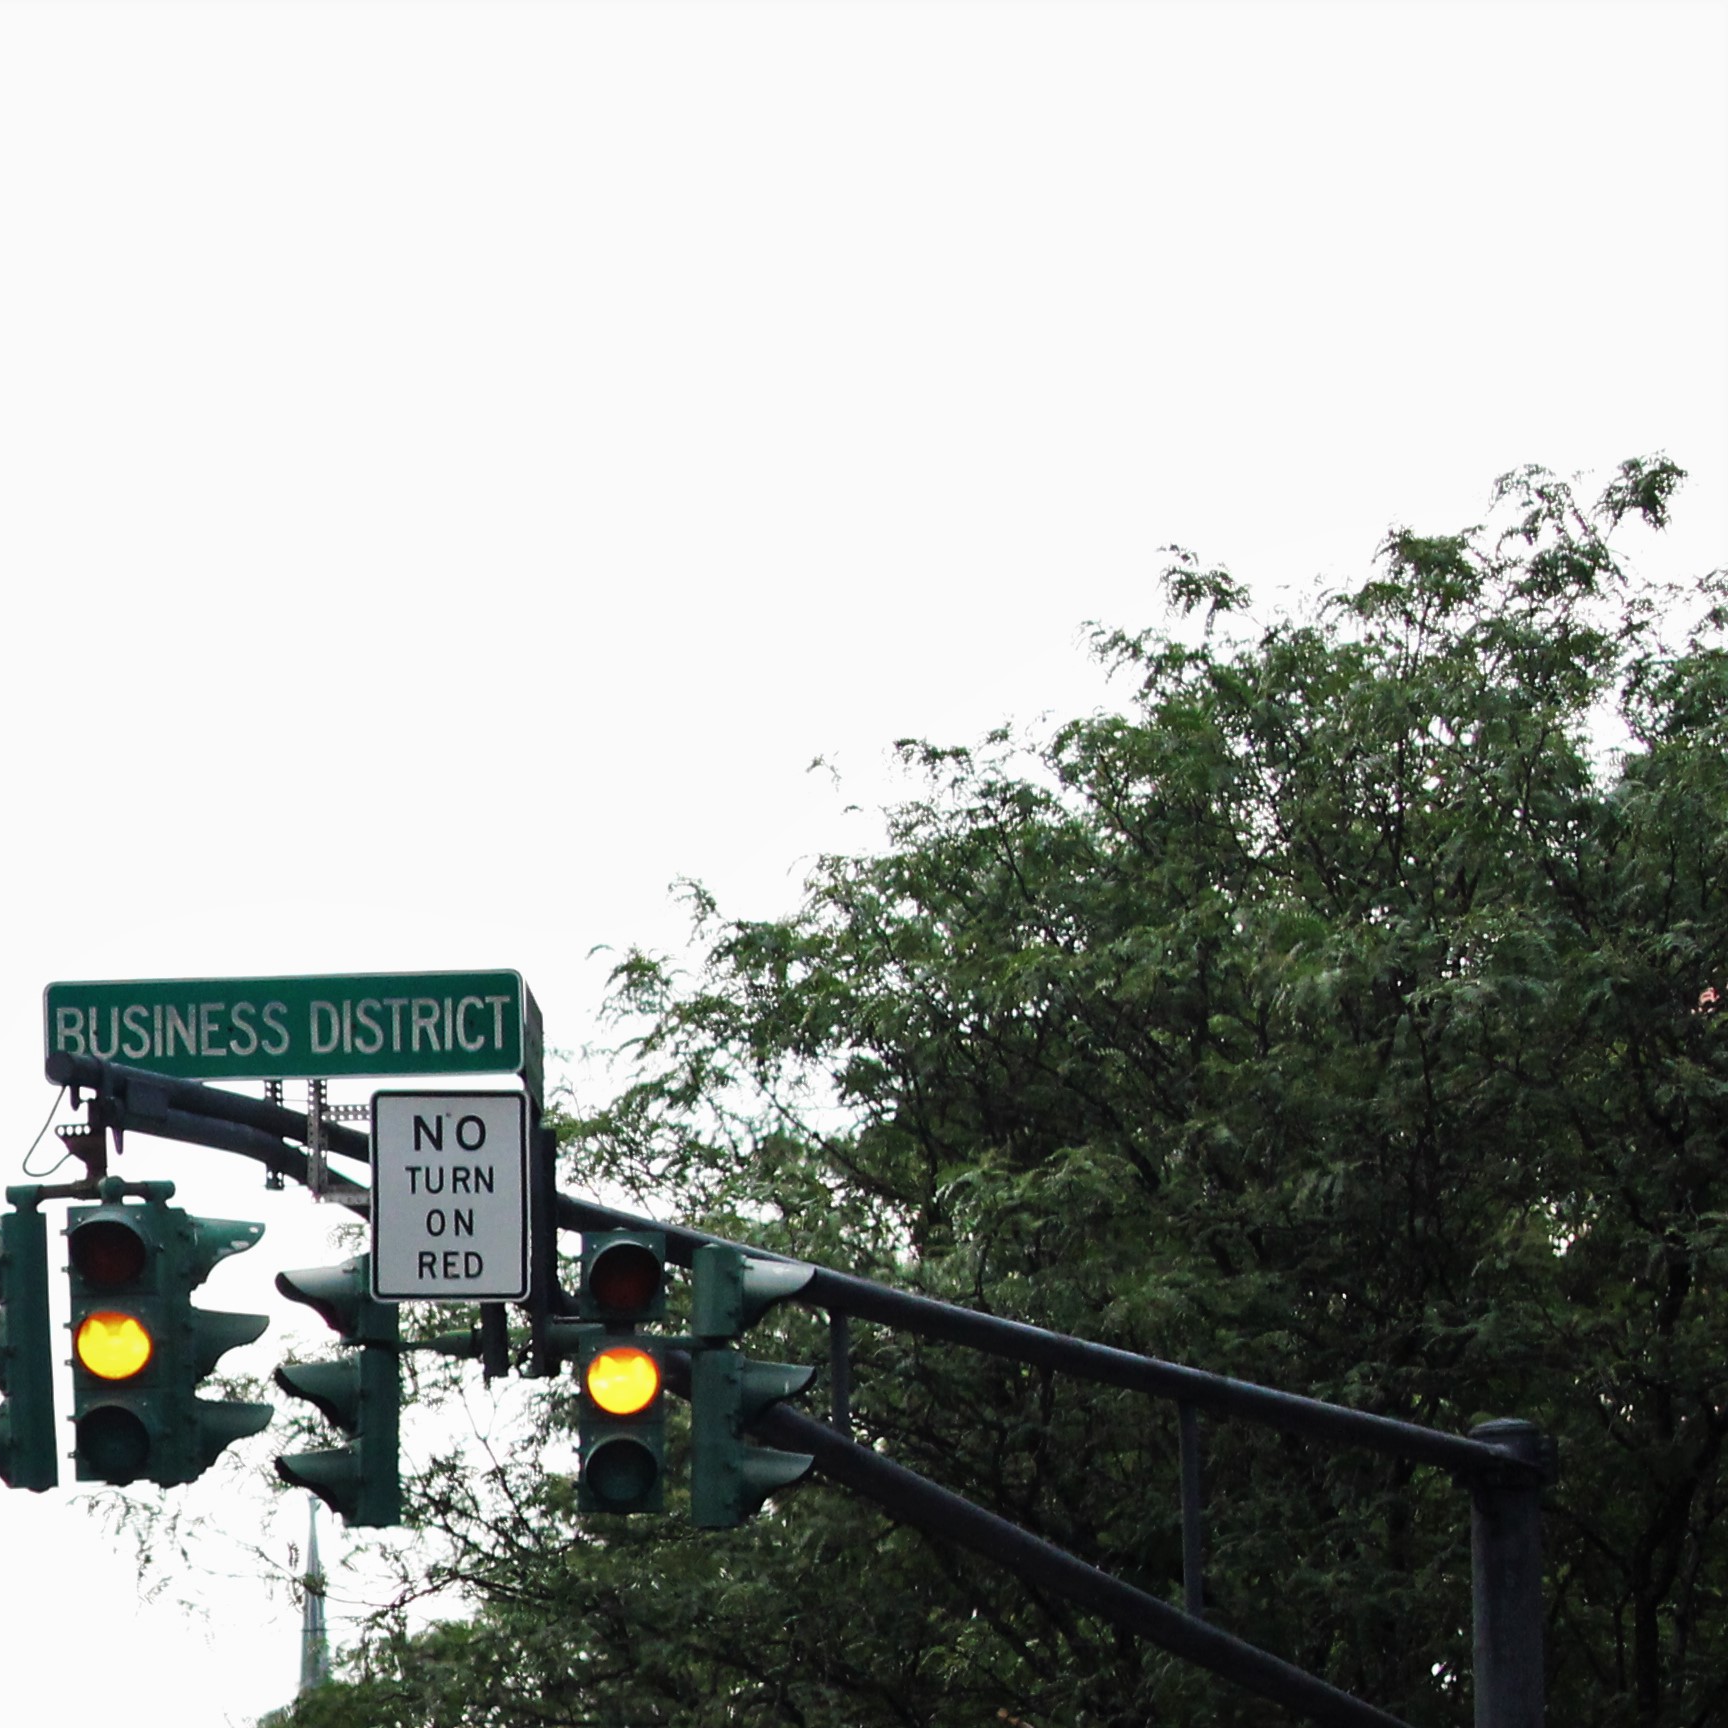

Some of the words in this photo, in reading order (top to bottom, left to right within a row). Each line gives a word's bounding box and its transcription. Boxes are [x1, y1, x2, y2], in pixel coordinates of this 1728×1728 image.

[55, 1000, 291, 1060] BUSINESS
[310, 994, 511, 1054] DISTRICT
[412, 1114, 487, 1151] NO
[405, 1165, 495, 1195] TURN
[425, 1208, 474, 1237] ON
[418, 1250, 483, 1280] RED
